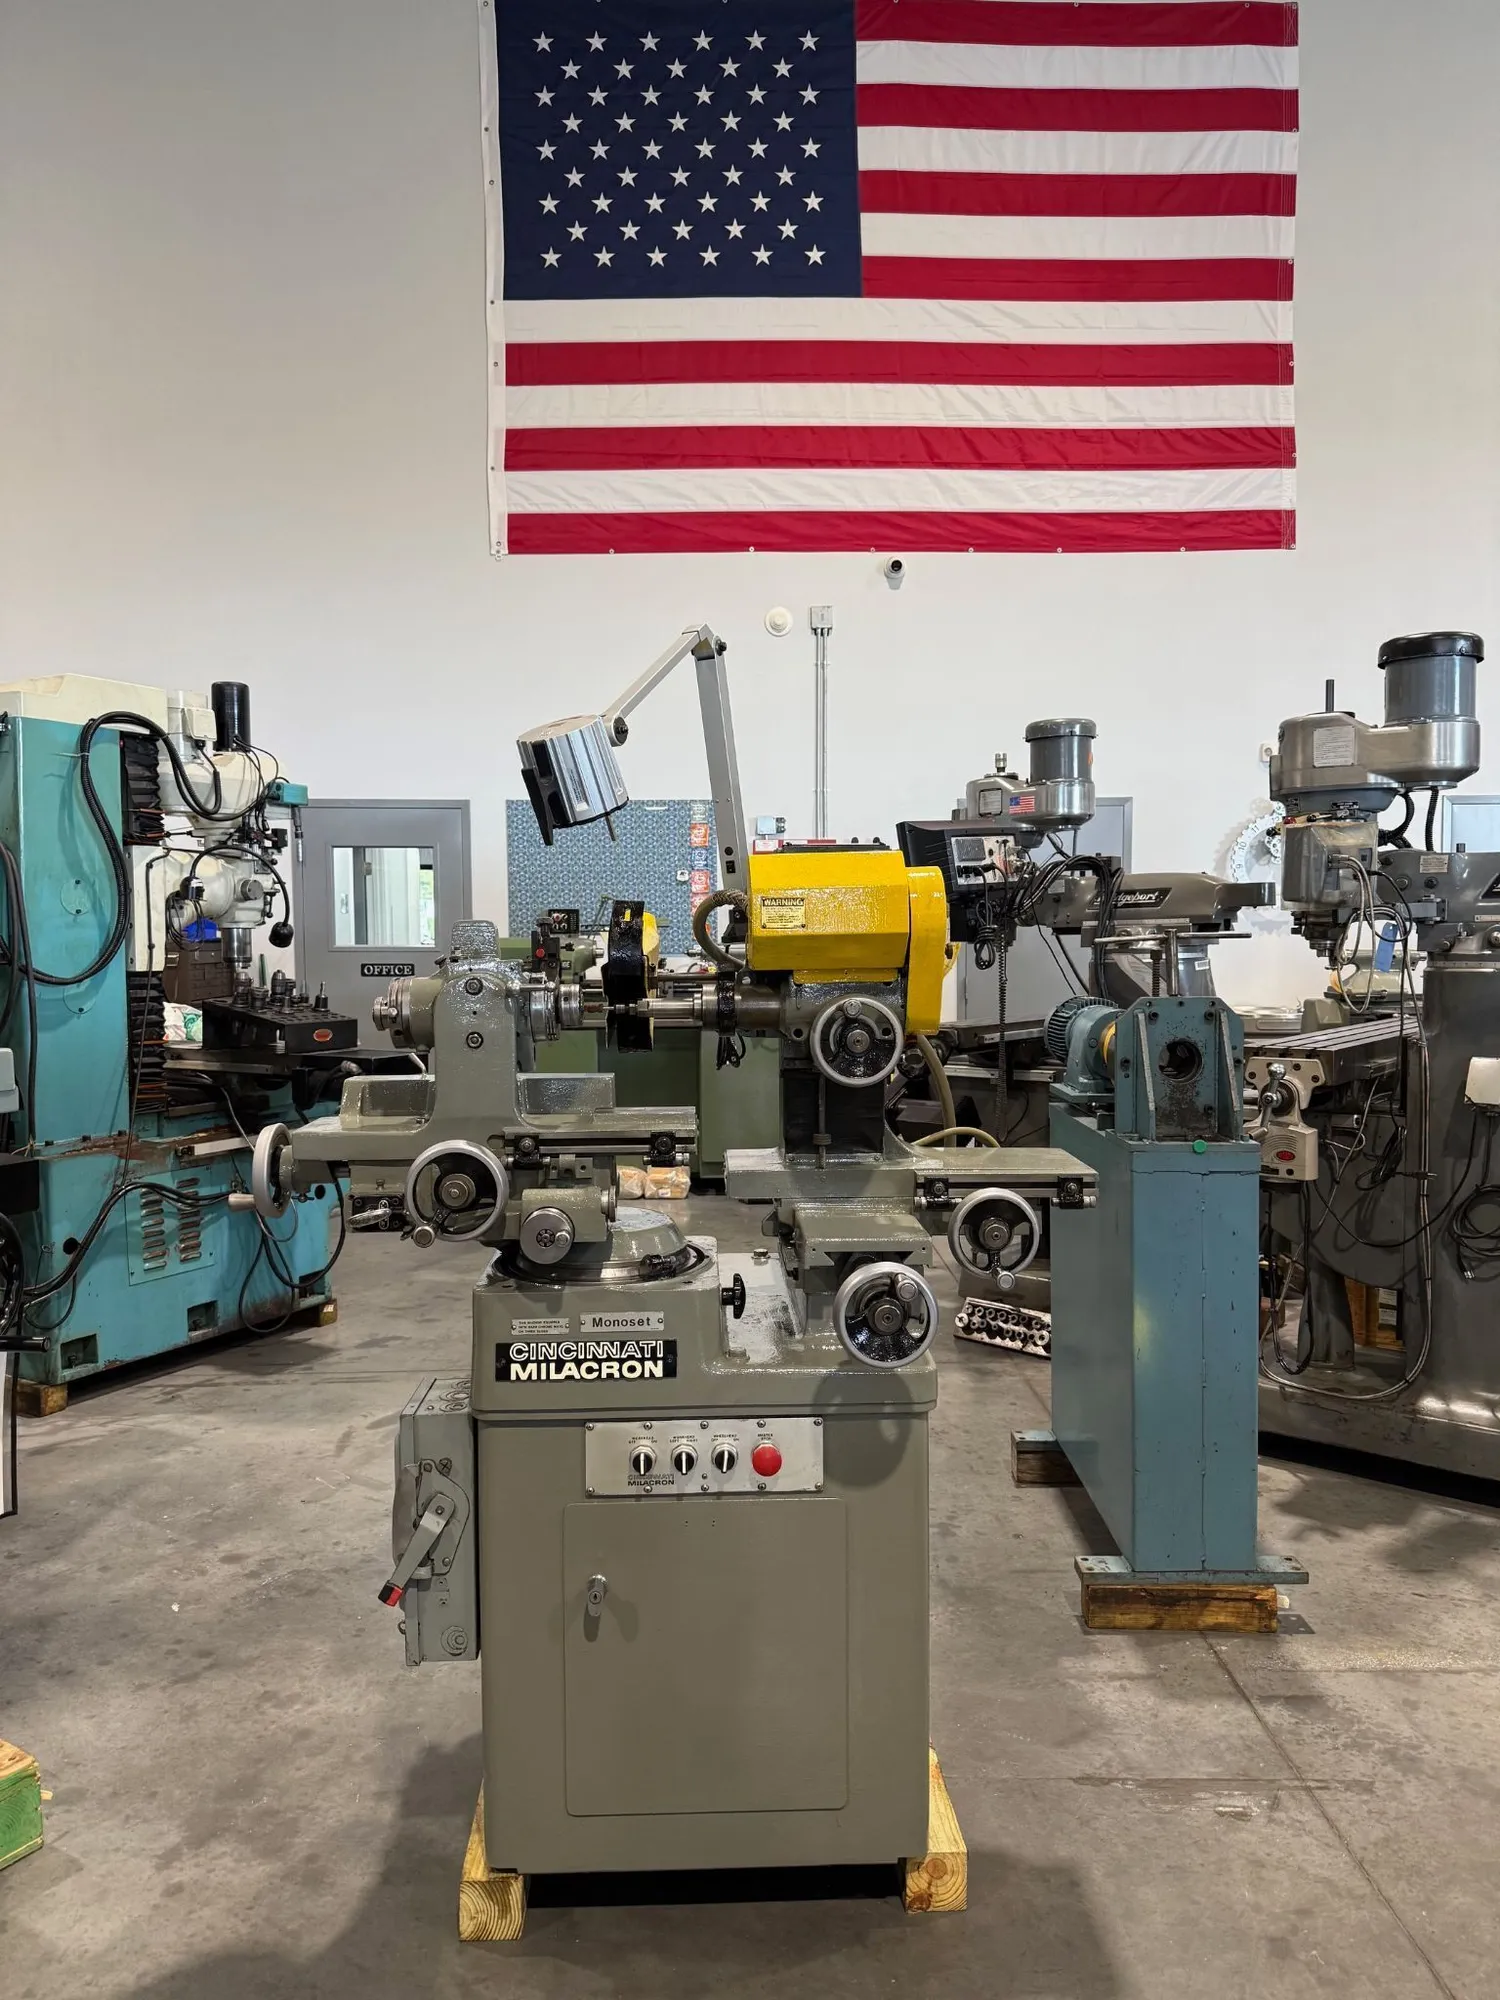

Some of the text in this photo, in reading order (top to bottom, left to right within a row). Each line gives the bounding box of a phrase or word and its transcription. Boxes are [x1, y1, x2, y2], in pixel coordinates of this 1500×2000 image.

[1238, 841, 1247, 851] 10
[764, 898, 803, 906] WARNING
[363, 965, 412, 975] OFFICE
[592, 1316, 651, 1328] Monoset
[509, 1340, 664, 1362] CINCINNATI
[510, 1360, 664, 1381] MILACRON
